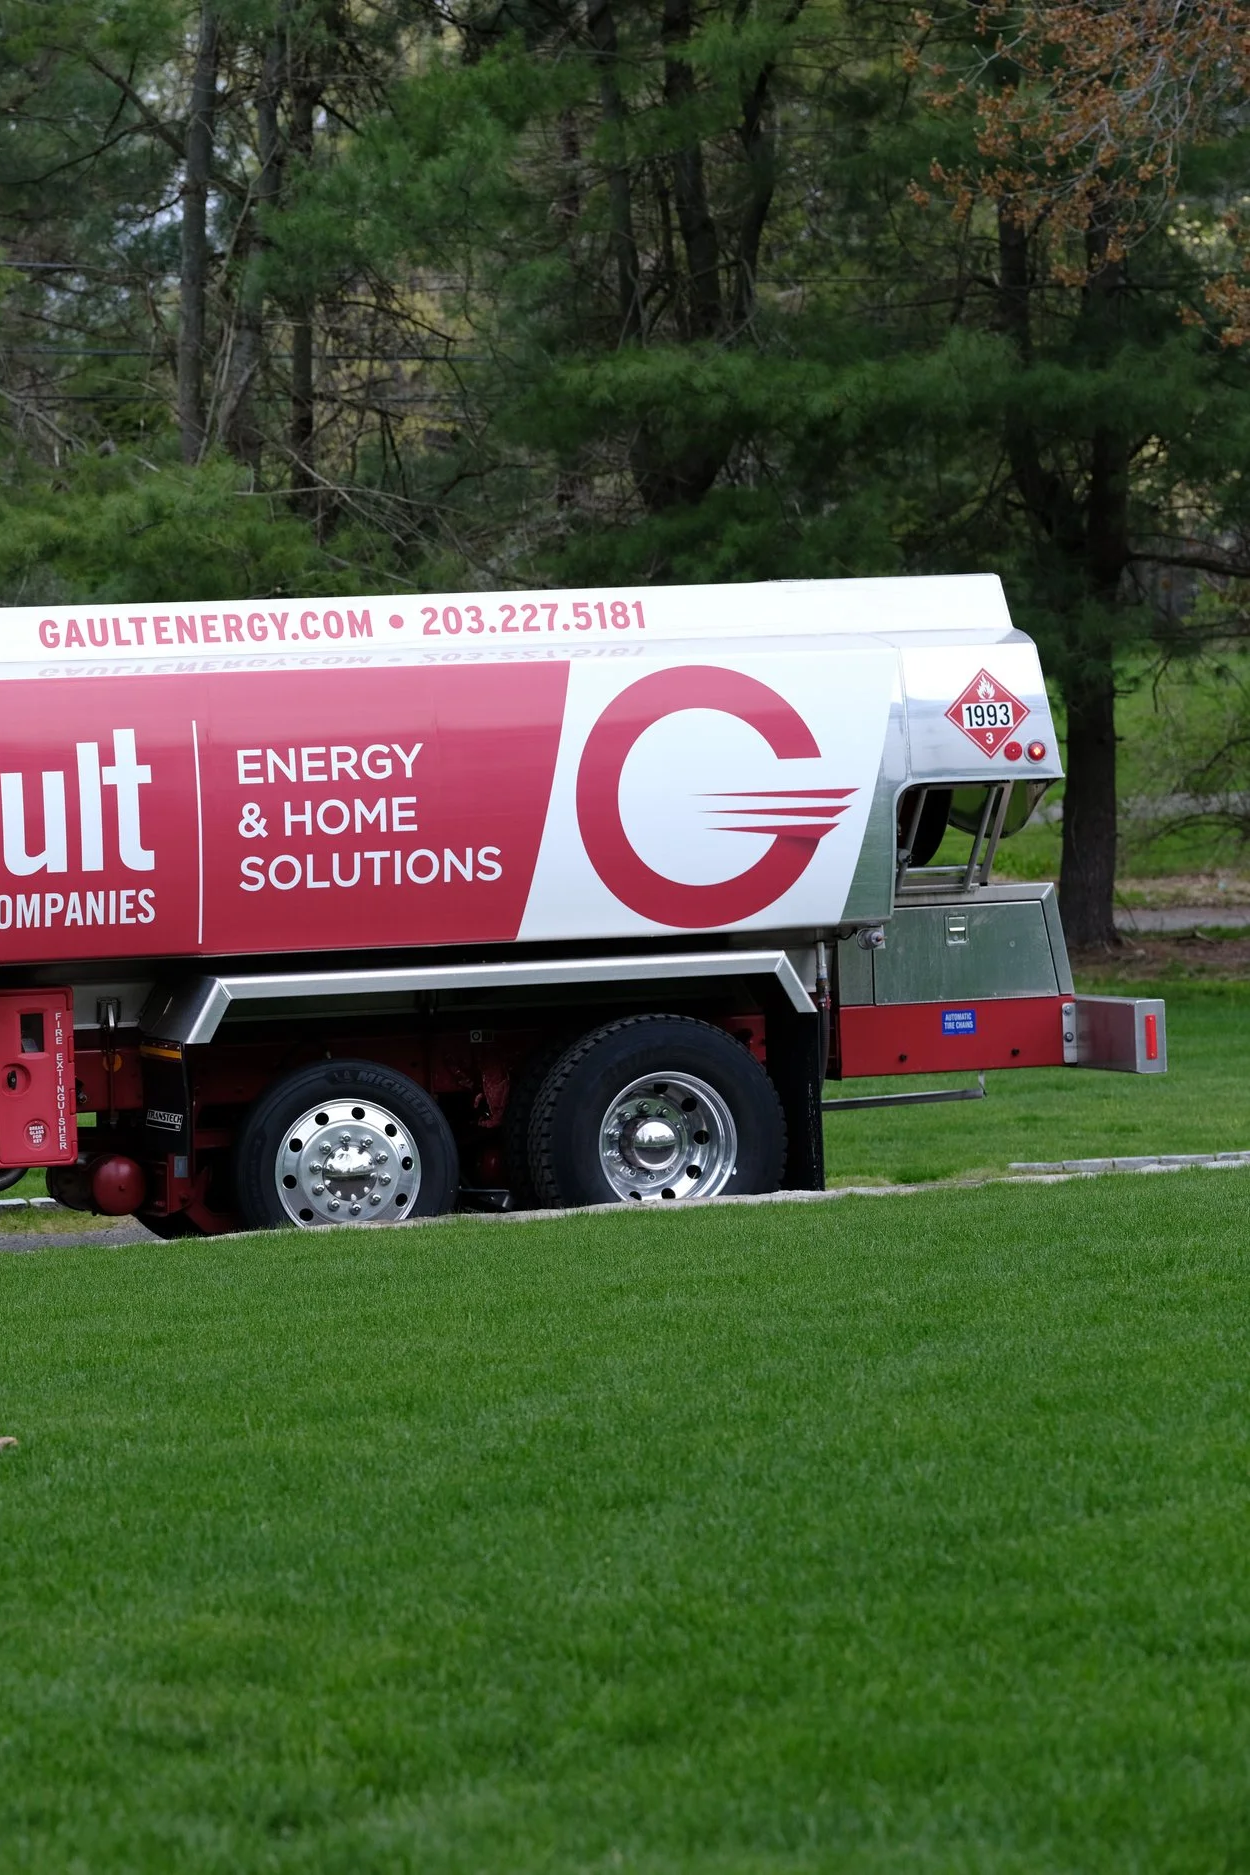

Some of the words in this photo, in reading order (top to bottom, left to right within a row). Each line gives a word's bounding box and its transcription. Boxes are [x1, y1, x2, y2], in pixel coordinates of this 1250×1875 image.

[39, 610, 373, 648] GAULTENERGY.COM
[423, 601, 645, 635] 203.227.5181
[965, 704, 1010, 727] 1993
[985, 732, 994, 744] 3
[236, 743, 423, 785] ENERGY
[238, 803, 268, 838] &
[284, 797, 417, 837] HOME
[239, 847, 502, 892] SOLUTIONS
[55, 1012, 63, 1045] FIRE
[945, 1012, 972, 1021] AUTOMATIC
[56, 1053, 68, 1150] EXTINGUISHER
[147, 1110, 183, 1124] TRANSTECH
[356, 1070, 436, 1125] MICHELIN
